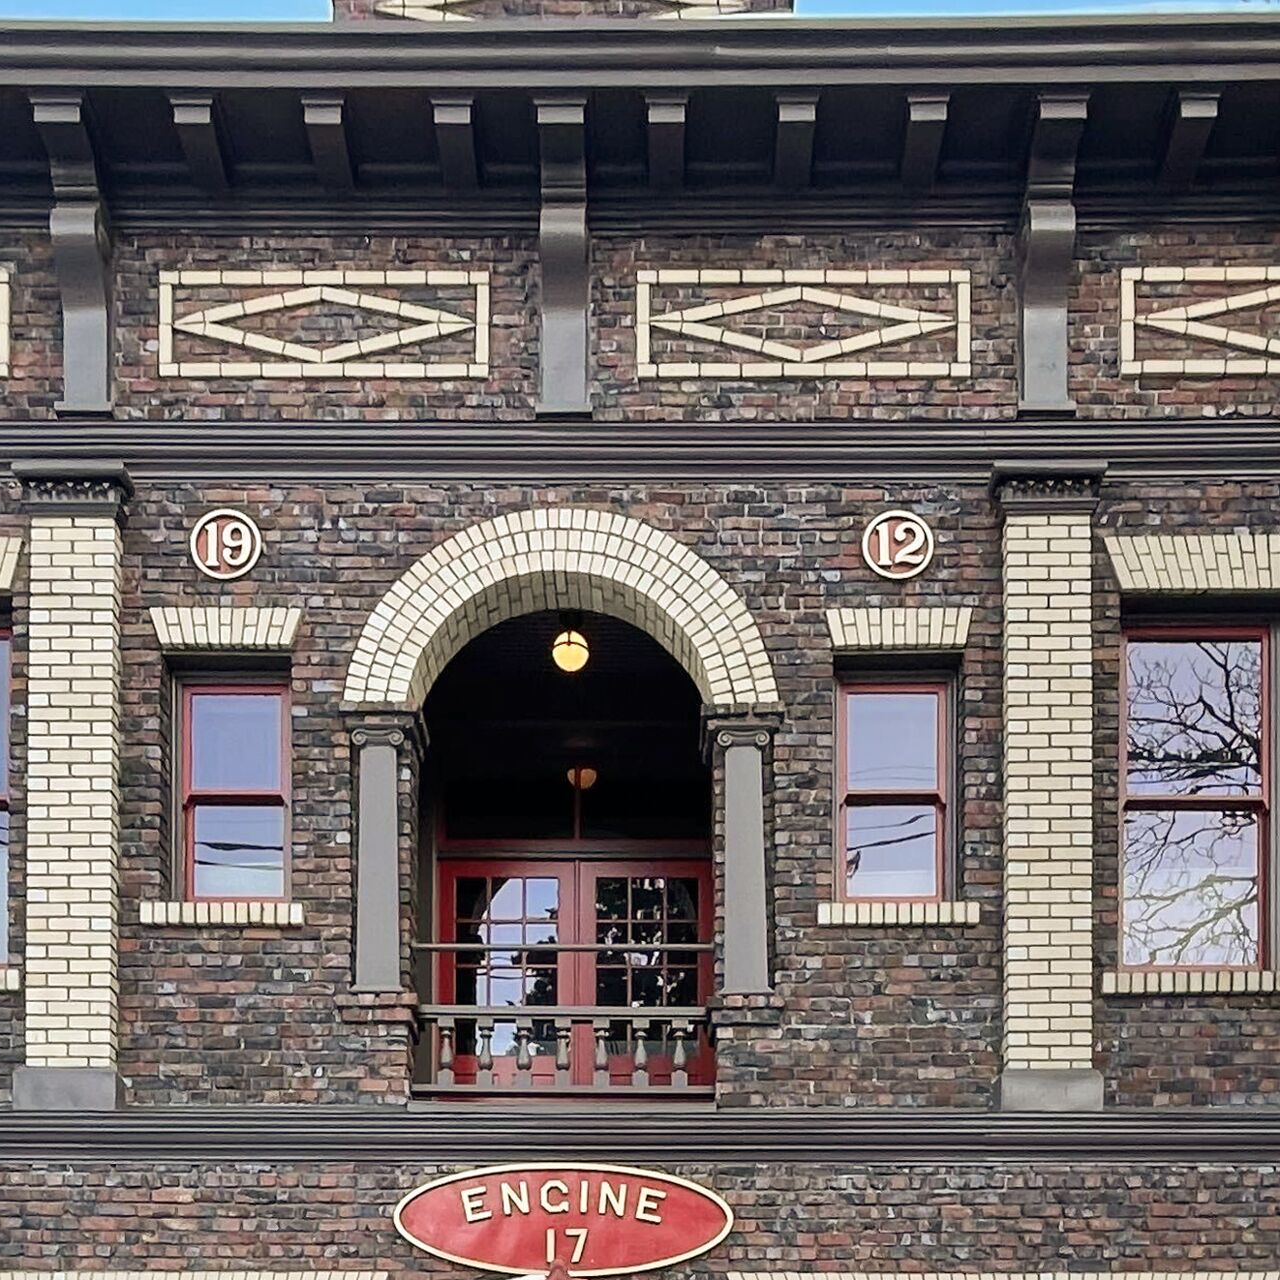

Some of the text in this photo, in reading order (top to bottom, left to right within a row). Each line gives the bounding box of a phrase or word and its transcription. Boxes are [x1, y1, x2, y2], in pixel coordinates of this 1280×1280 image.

[204, 521, 252, 567] 19
[875, 521, 926, 566] 12
[460, 1179, 667, 1224] ENGINE
[545, 1228, 588, 1264] 17
